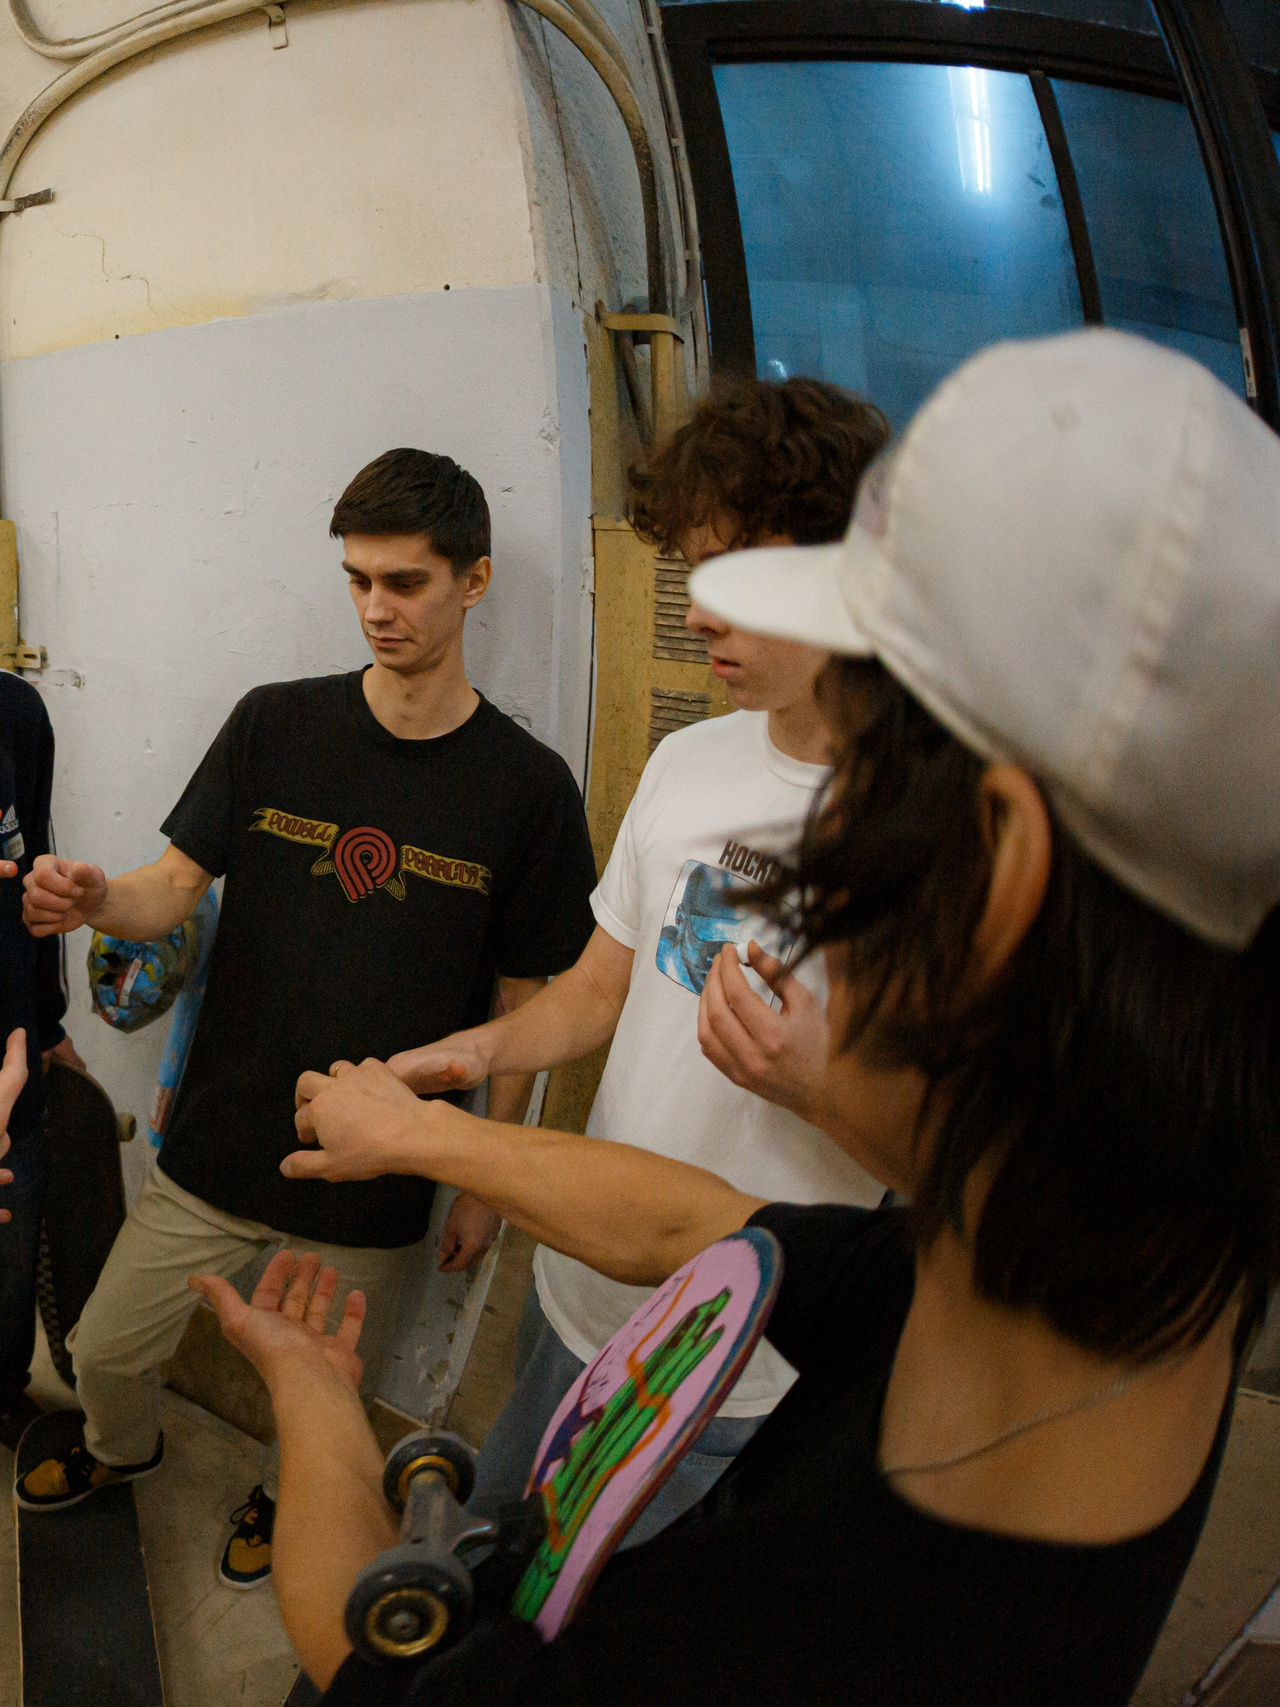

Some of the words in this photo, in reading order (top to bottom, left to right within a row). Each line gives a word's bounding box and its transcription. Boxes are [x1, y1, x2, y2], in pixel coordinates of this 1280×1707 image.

[268, 811, 332, 842] POWELL
[405, 847, 480, 885] PERALTA
[717, 838, 780, 886] HOCK
